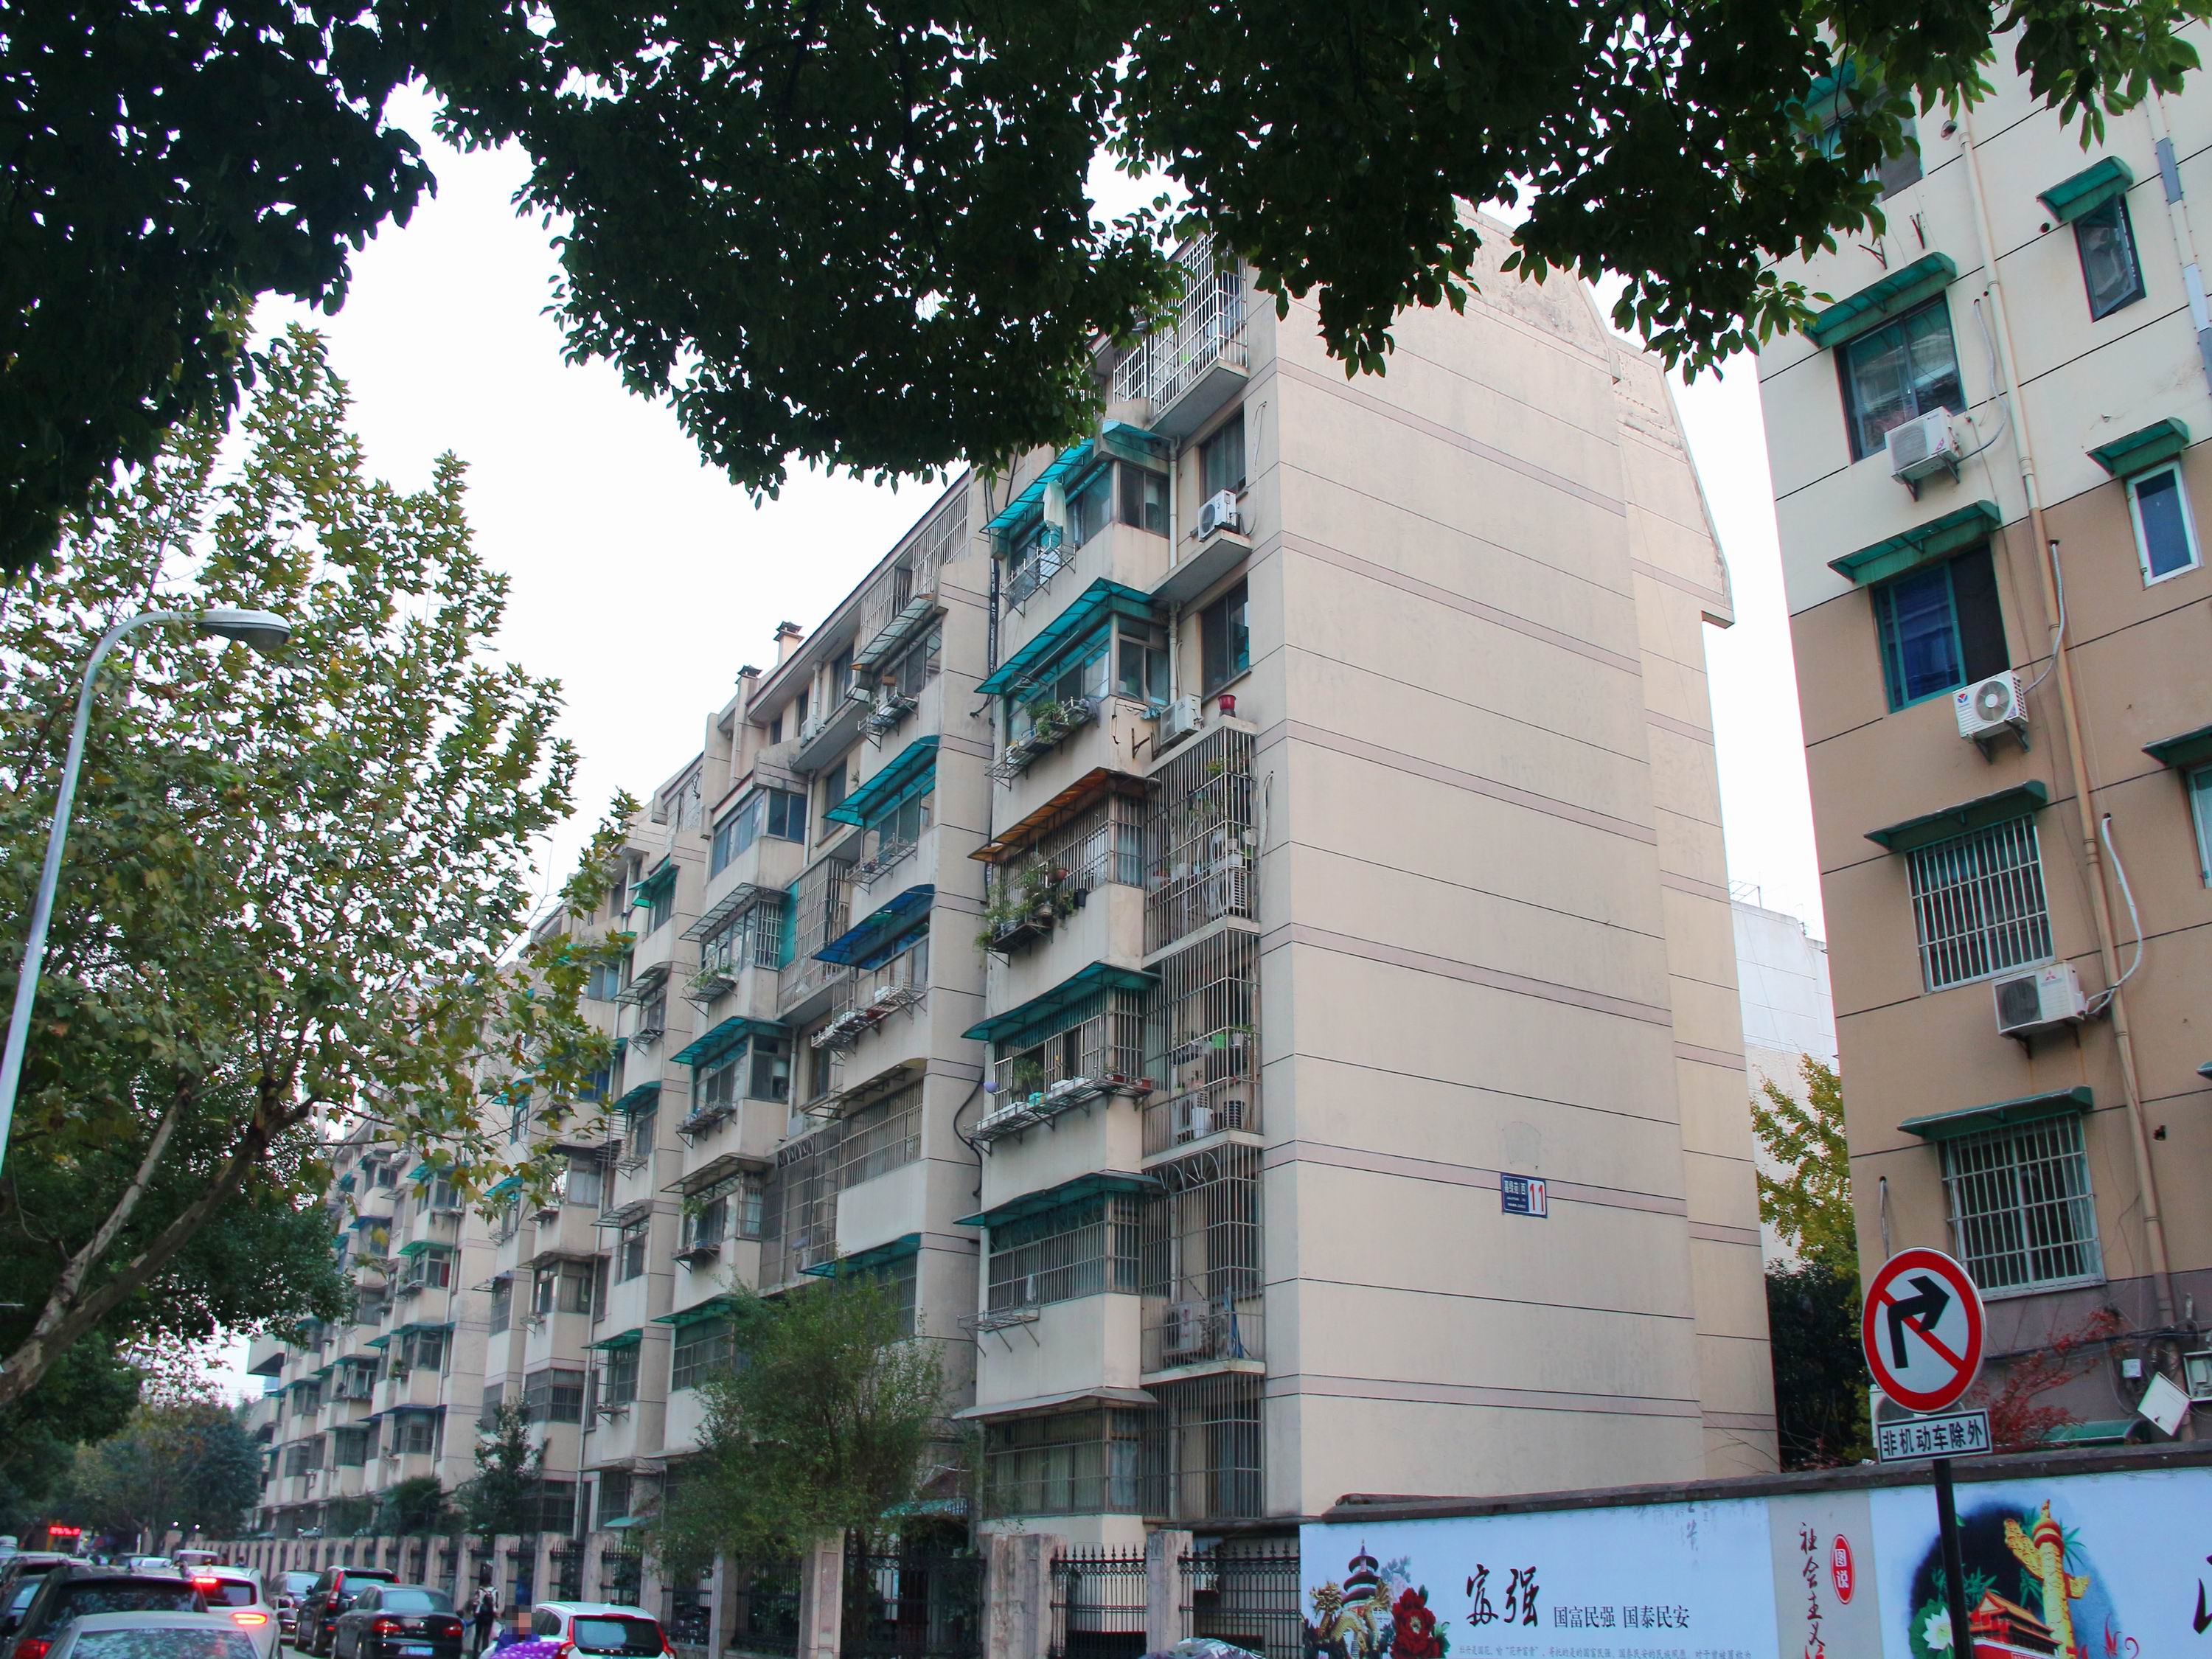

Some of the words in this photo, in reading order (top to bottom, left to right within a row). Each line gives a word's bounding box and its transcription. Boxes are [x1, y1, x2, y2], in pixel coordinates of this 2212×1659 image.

[1530, 1183, 1544, 1211] 11
[1882, 1419, 1983, 1456] 非机动车除外
[1799, 1522, 1826, 1646] 社会主义
[1834, 1548, 1850, 1588] 图说
[1466, 1563, 1540, 1627] 富强
[1554, 1605, 1616, 1629] 国富民强
[1624, 1604, 1691, 1629] 国泰民安
